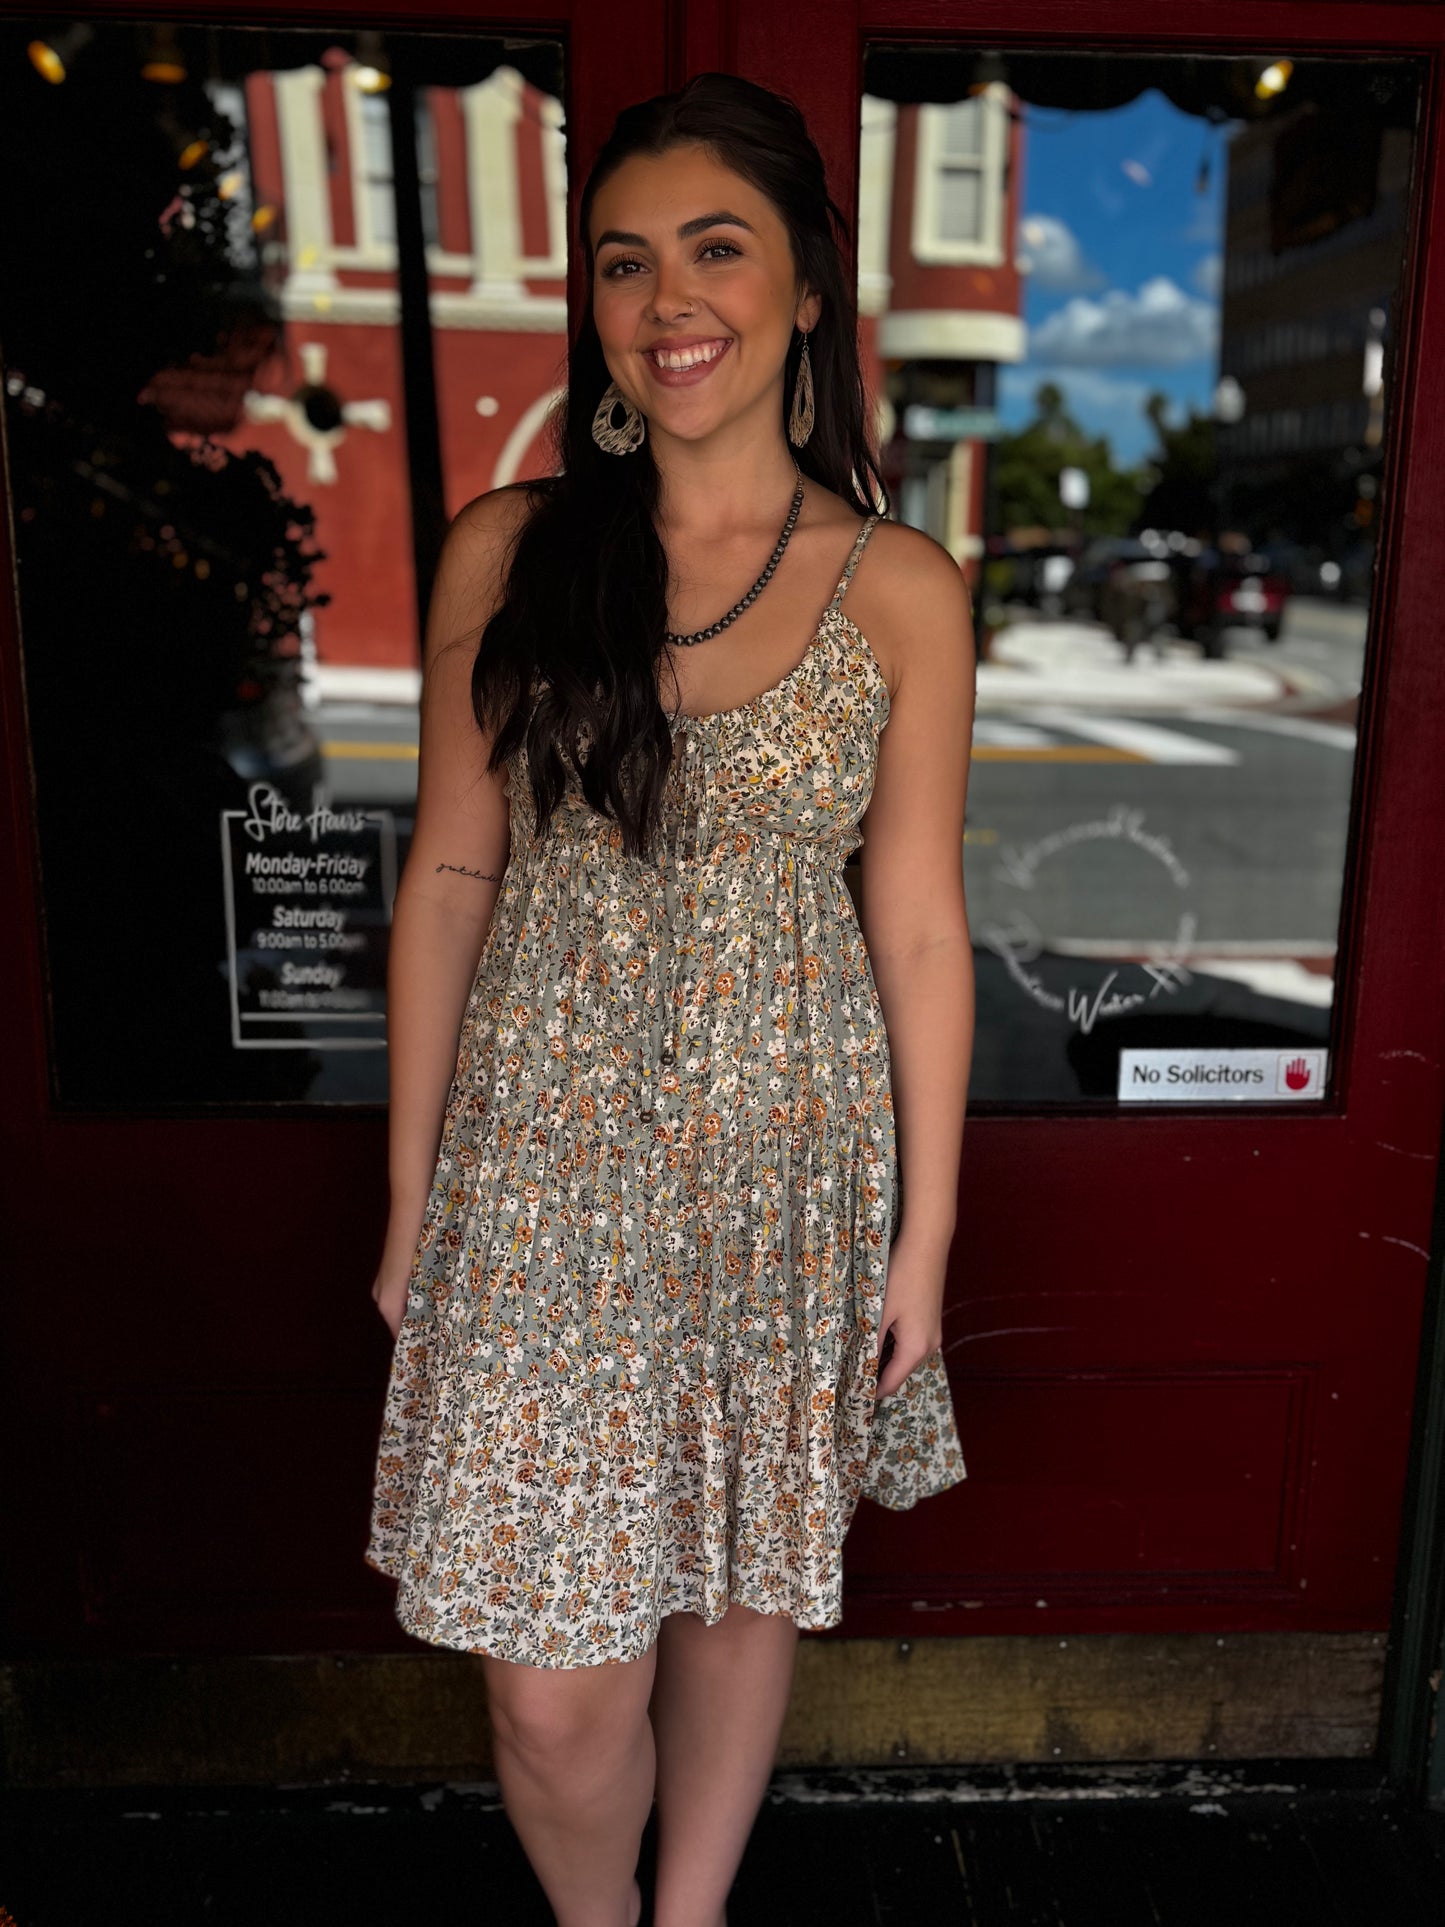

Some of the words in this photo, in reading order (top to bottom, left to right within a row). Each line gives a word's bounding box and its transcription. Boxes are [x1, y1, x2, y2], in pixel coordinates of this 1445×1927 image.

[244, 783, 301, 841] Store
[305, 806, 365, 842] Hours
[245, 851, 367, 879] Monday-Friday
[303, 879, 317, 894] to
[272, 904, 345, 932] Saturday
[303, 934, 317, 949] to
[281, 961, 342, 989] Sunday
[1132, 1065, 1160, 1084] No
[1167, 1064, 1264, 1084] Solicitors
